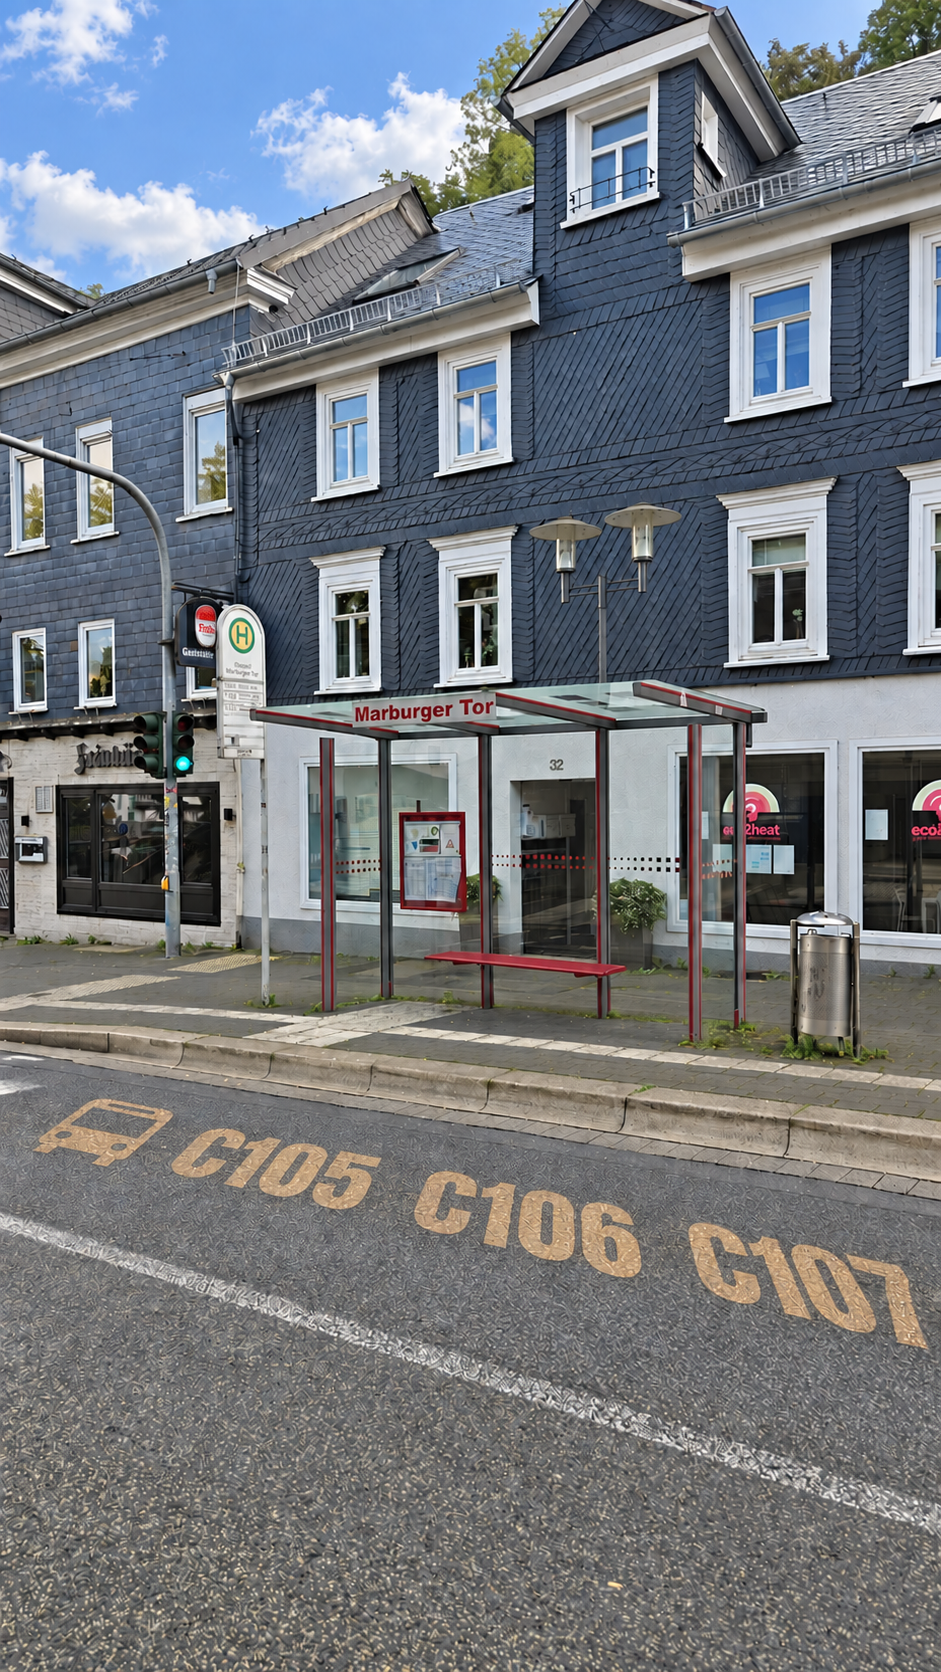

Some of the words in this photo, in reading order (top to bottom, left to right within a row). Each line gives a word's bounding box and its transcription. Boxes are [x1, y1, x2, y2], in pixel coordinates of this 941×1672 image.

[236, 625, 248, 646] H
[354, 703, 453, 722] Marburger
[459, 699, 495, 716] Tor
[549, 759, 564, 771] 32
[171, 1128, 382, 1210] C105
[413, 1170, 642, 1278] C106
[688, 1222, 930, 1350] C107
